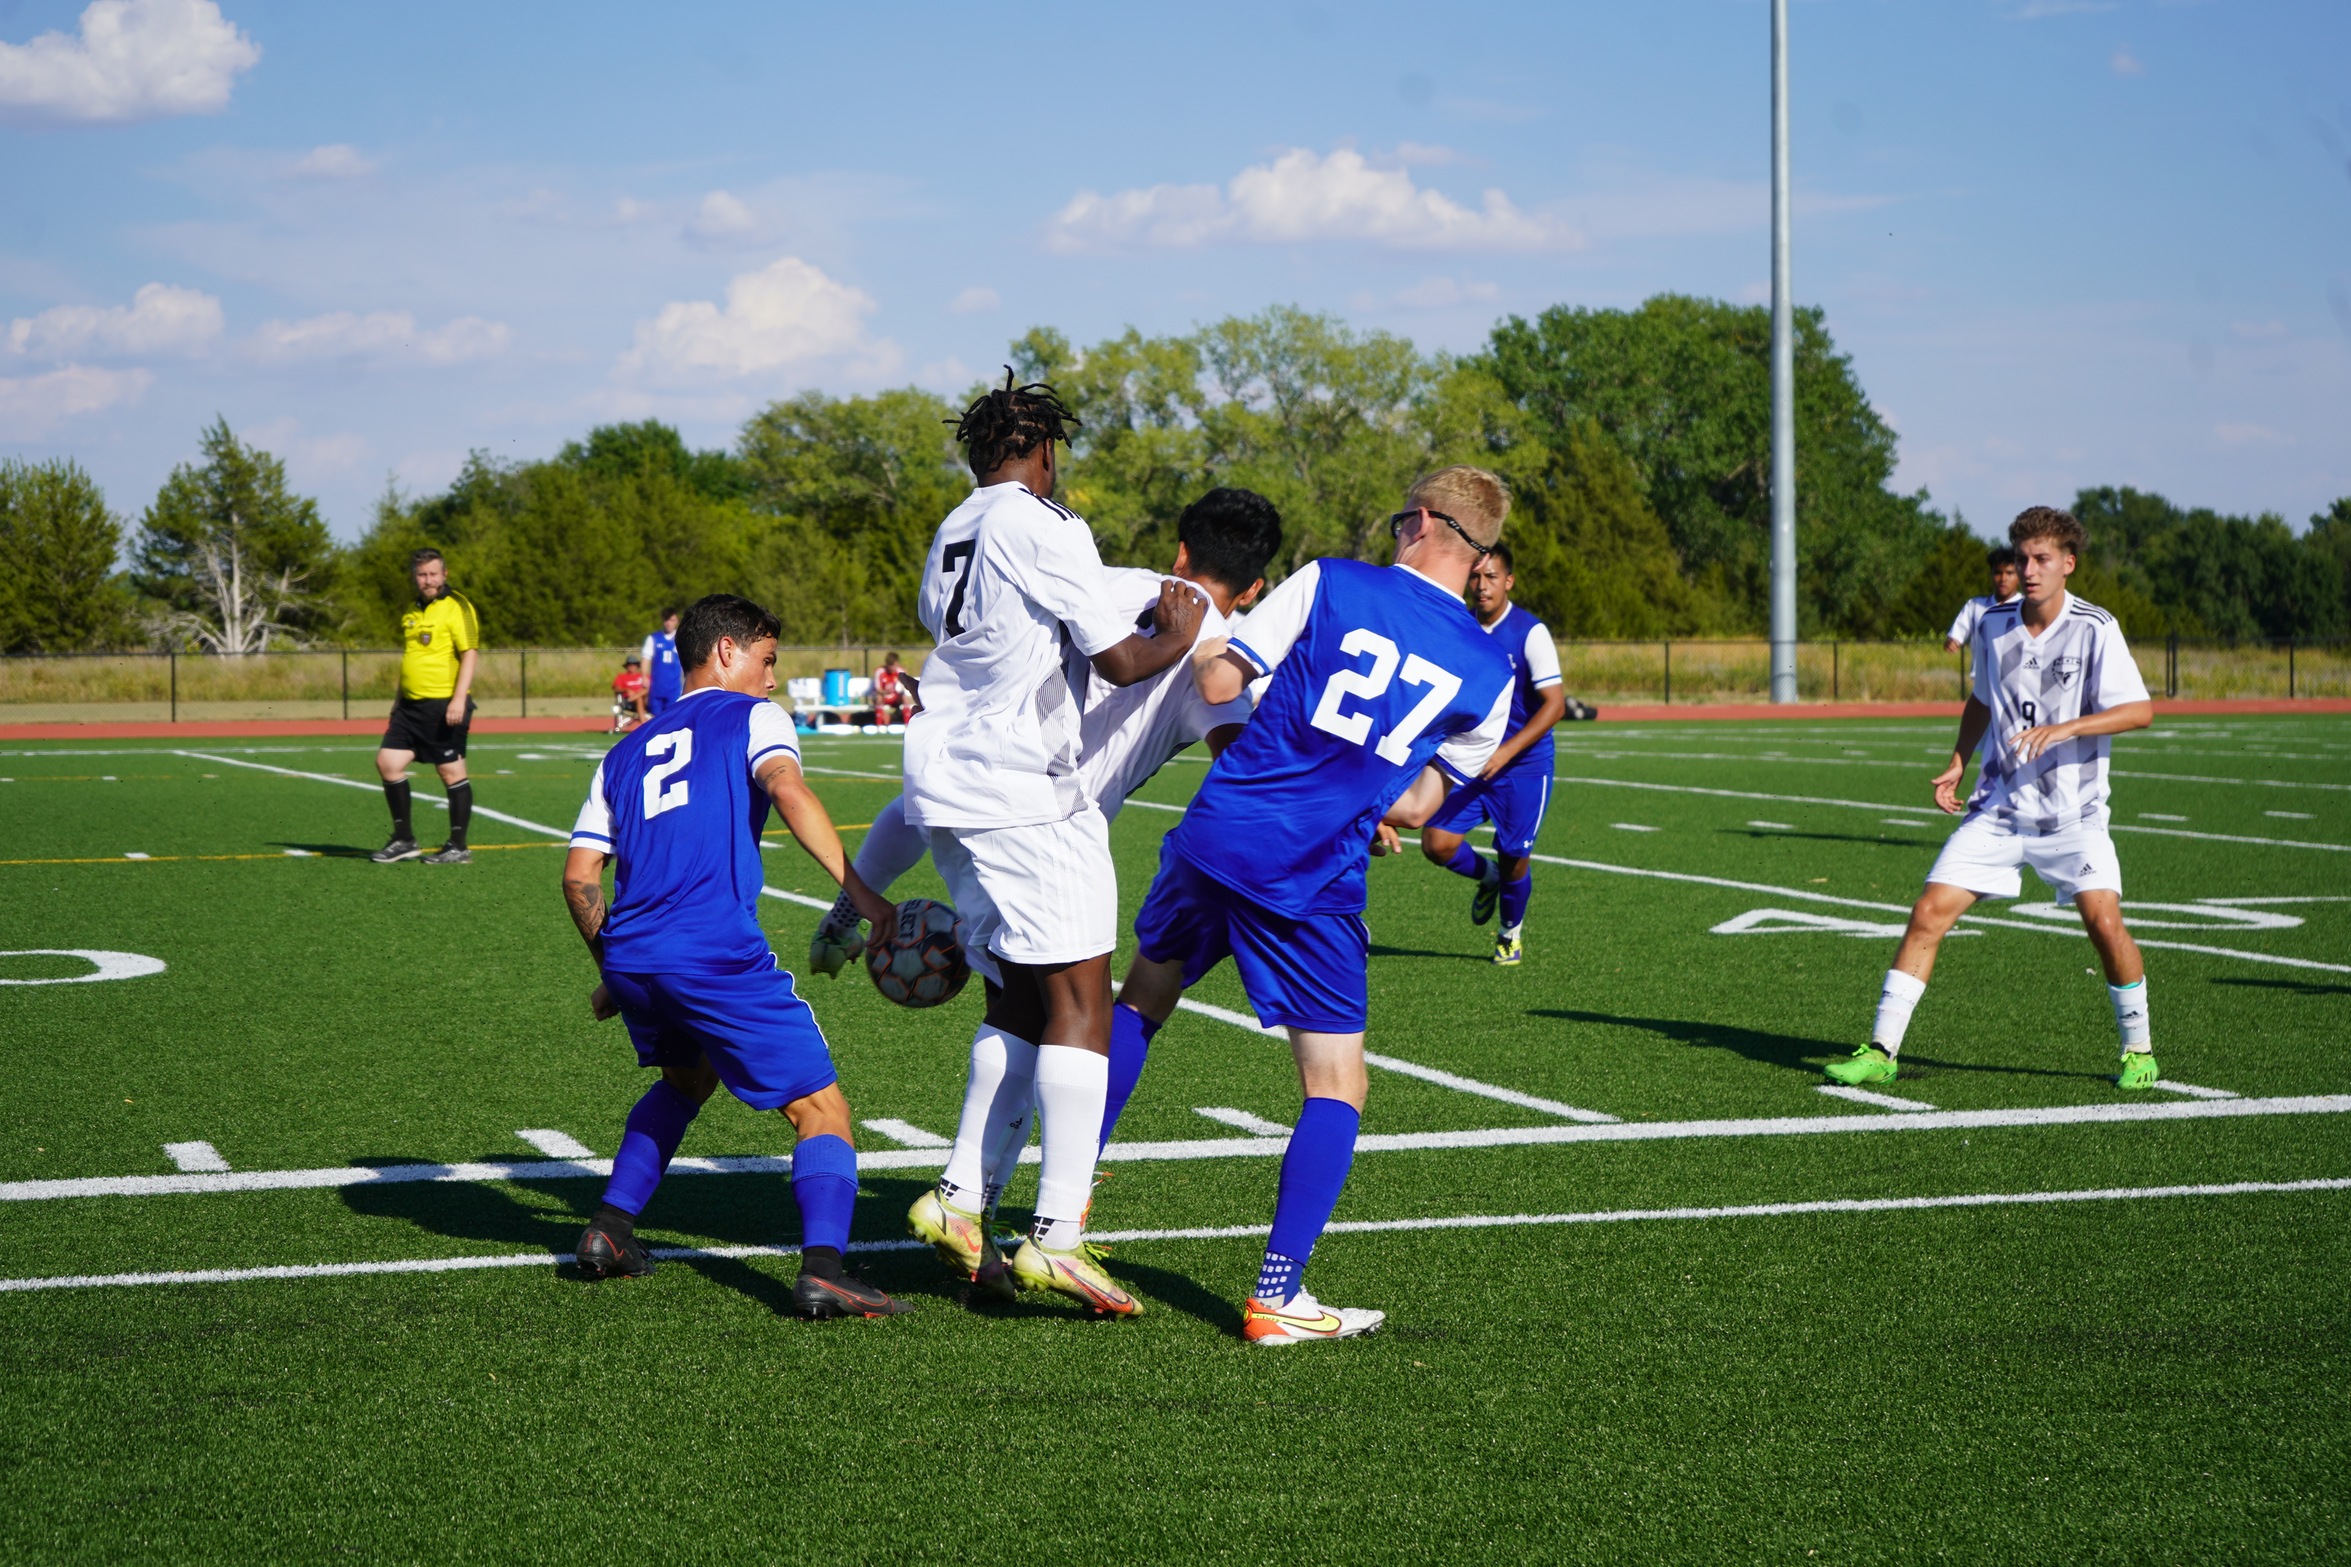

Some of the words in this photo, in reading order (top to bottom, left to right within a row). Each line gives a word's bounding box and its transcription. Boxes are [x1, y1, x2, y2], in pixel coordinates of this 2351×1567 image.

[942, 539, 976, 638] 7
[1310, 628, 1463, 767] 27
[2022, 701, 2036, 731] 9
[643, 727, 693, 820] 2
